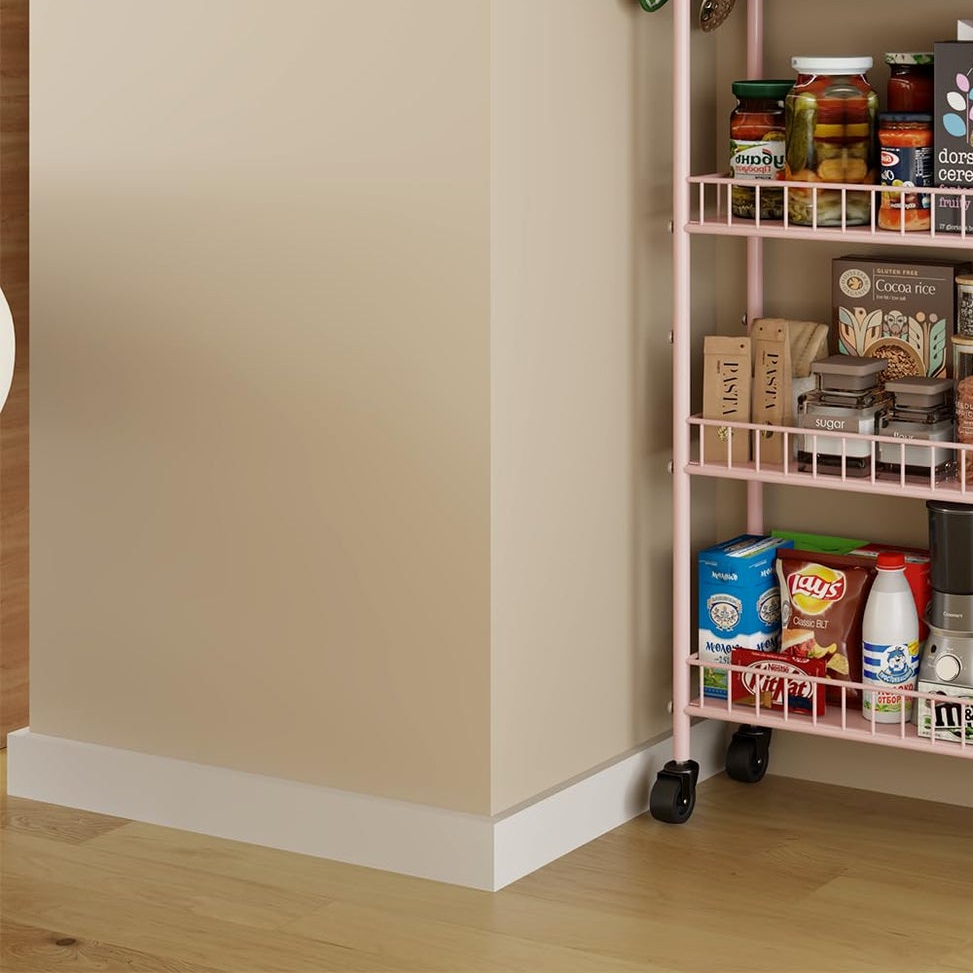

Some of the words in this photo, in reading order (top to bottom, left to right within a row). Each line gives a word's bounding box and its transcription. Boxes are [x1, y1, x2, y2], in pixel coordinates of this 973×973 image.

[876, 279, 912, 294] Cocoa
[914, 282, 936, 295] rice
[722, 362, 739, 415] PASTA
[765, 354, 779, 409] PASTA
[815, 419, 845, 430] sugar
[792, 574, 842, 598] Lay's
[793, 617, 815, 628] Classic
[816, 620, 829, 628] BLT
